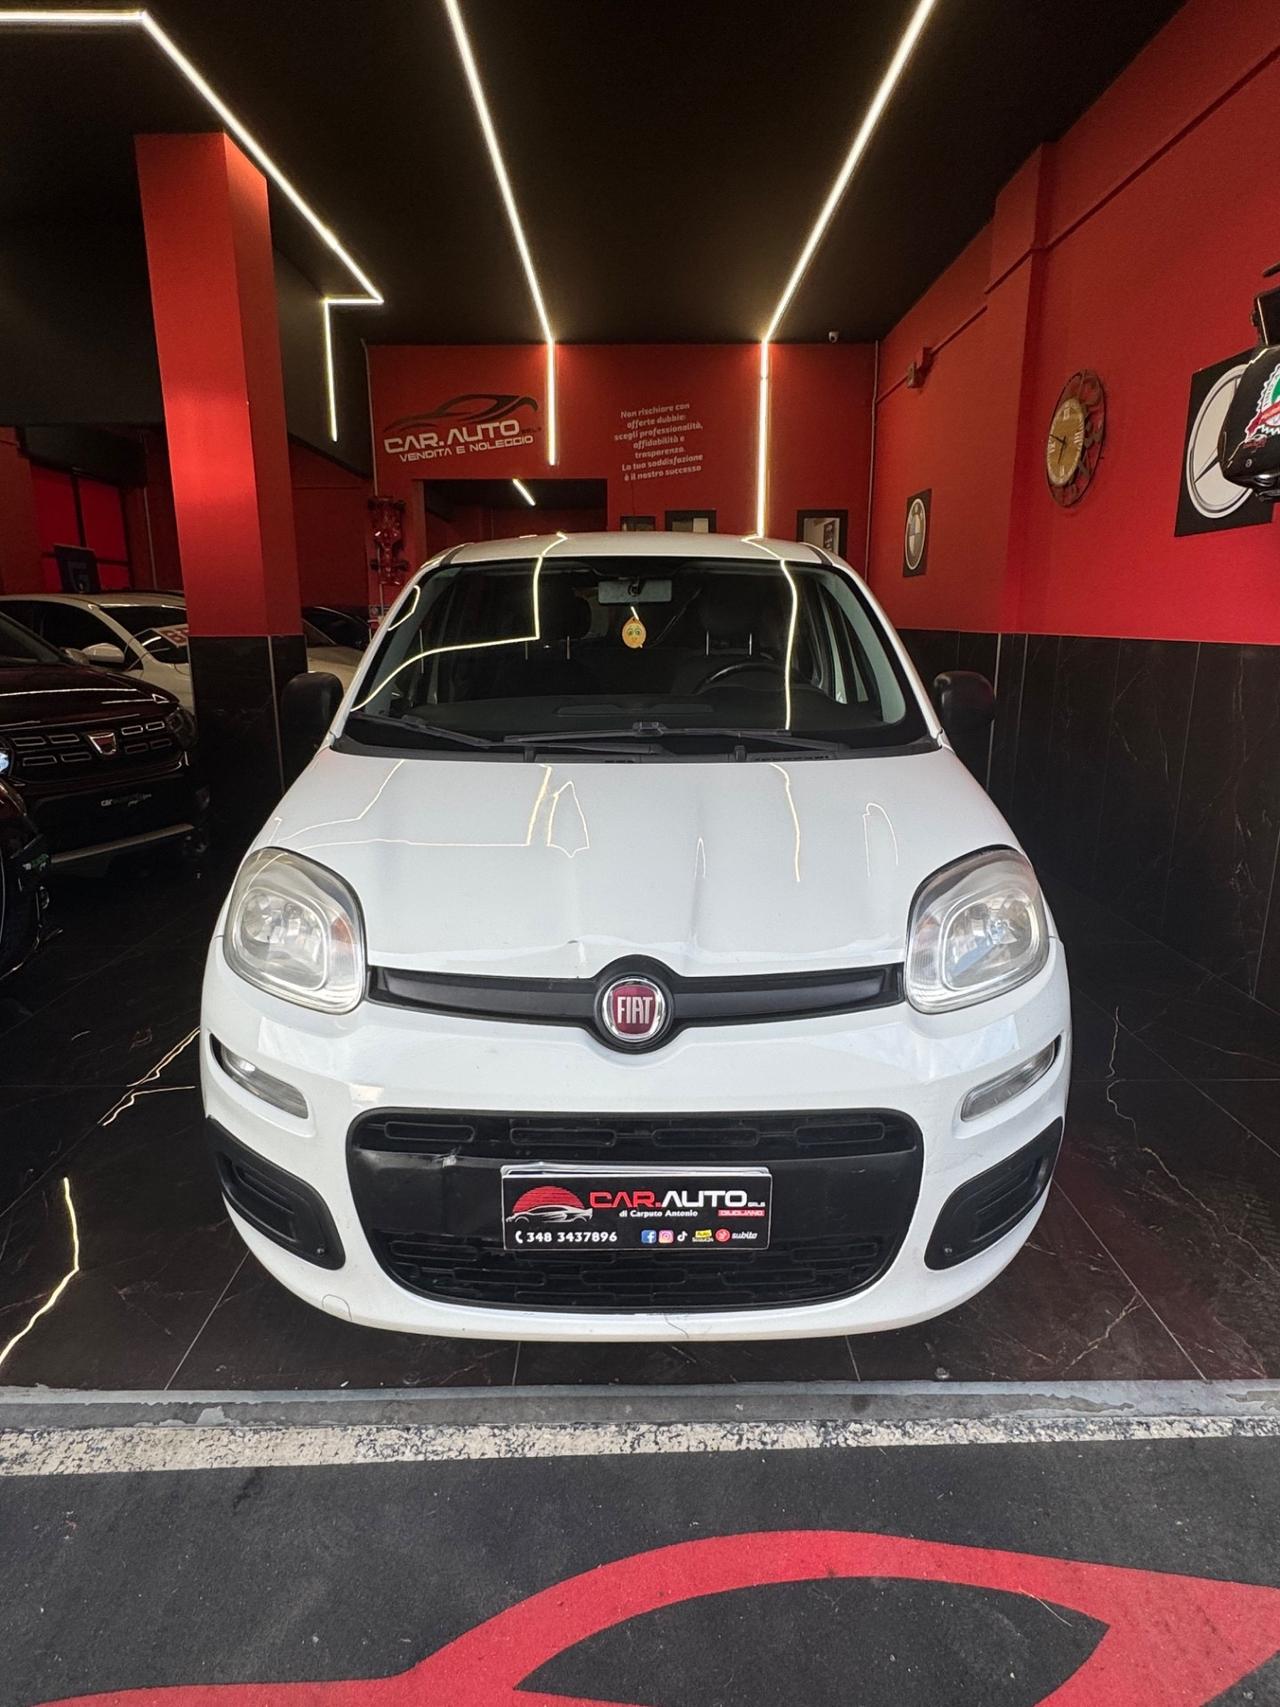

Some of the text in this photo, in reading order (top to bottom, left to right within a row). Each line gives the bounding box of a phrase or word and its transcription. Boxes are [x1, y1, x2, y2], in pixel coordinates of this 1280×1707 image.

[620, 411, 637, 419] Non
[638, 404, 673, 416] rischiare
[627, 419, 656, 430] offerte
[384, 419, 520, 454] CAR.AUTO
[614, 430, 639, 441] scegli
[400, 435, 534, 462] VENDITA E NOLEGGIO
[622, 454, 704, 472] La tua soddisfazione
[637, 470, 664, 480] nostro
[665, 465, 702, 476] successo
[617, 996, 653, 1025] FIAT
[629, 1210, 663, 1219] Carputo
[664, 1209, 699, 1217] Antonio
[526, 1232, 553, 1243] 348
[557, 1232, 618, 1243] 3437896
[731, 1231, 758, 1240] subito
